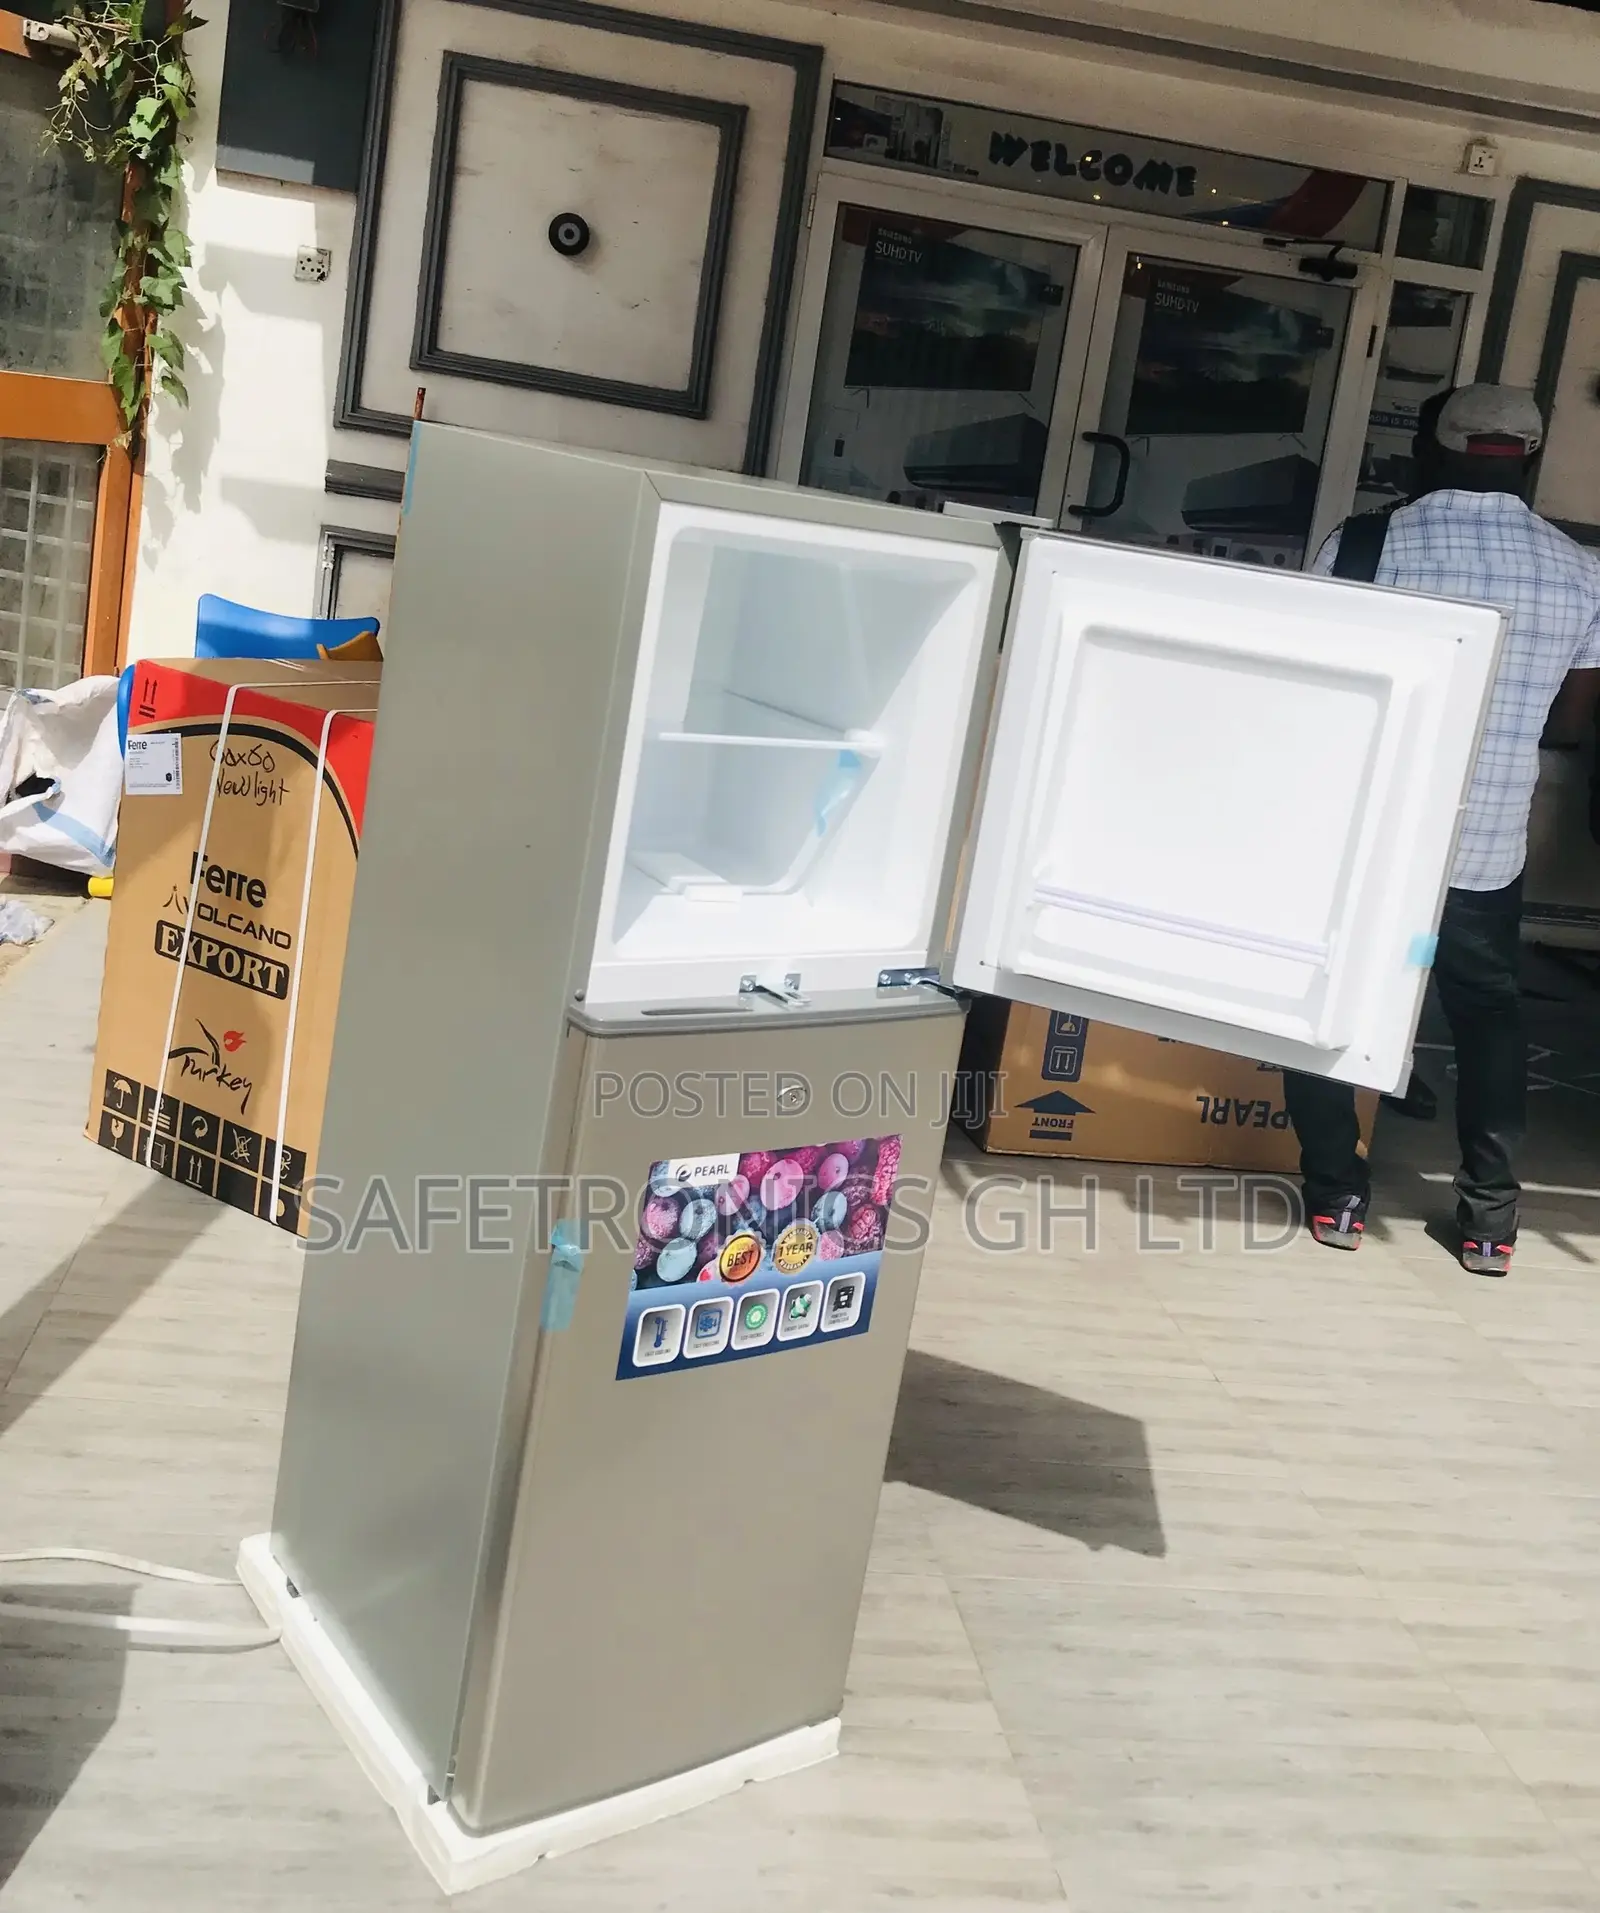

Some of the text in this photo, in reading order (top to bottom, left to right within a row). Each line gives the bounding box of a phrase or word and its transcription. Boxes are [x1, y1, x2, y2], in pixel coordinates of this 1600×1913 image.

[988, 130, 1197, 198] WELCOME
[190, 851, 267, 908] Ferre
[159, 924, 286, 995] EXPORT
[1032, 1117, 1075, 1129] FRONT
[1196, 1095, 1290, 1130] PEARL
[694, 1164, 730, 1178] PEARL
[727, 1250, 755, 1267] BEST
[785, 1242, 814, 1256] YEAR
